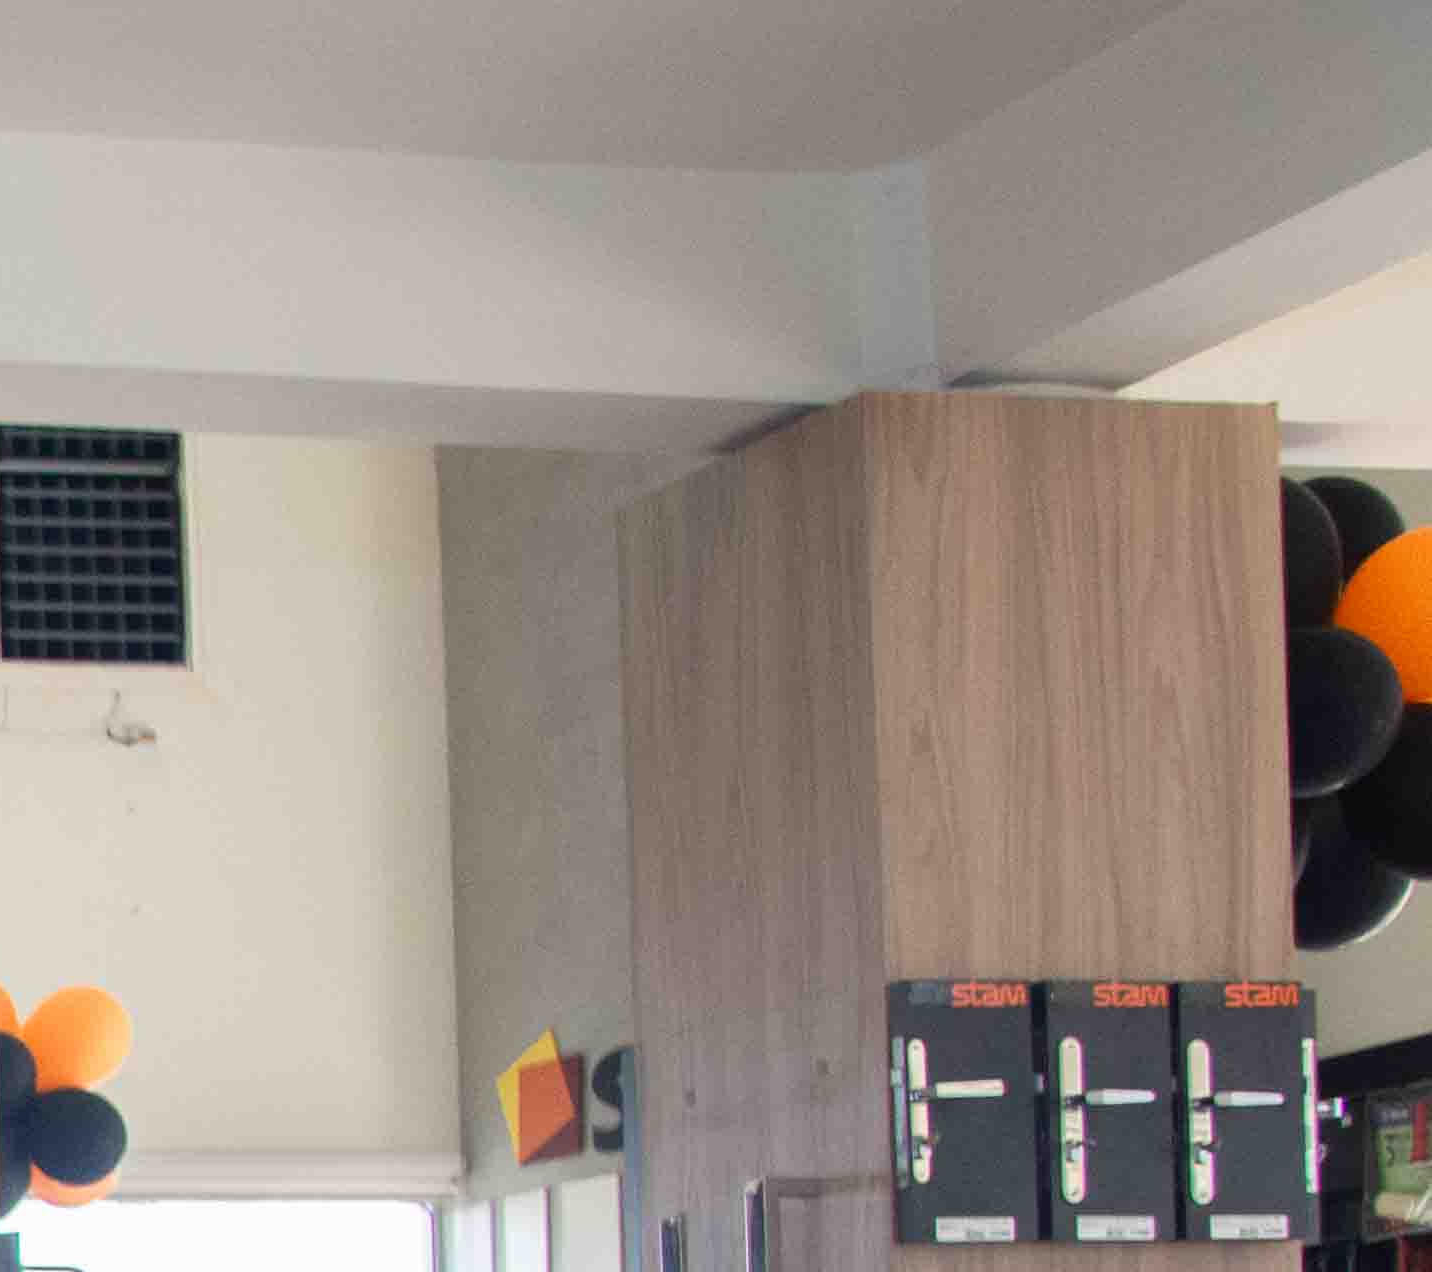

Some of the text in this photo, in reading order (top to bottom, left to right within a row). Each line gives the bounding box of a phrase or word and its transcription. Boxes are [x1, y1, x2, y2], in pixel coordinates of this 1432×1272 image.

[951, 981, 1029, 1008] stam
[1092, 981, 1172, 1008] stam
[1224, 981, 1300, 1008] stam
